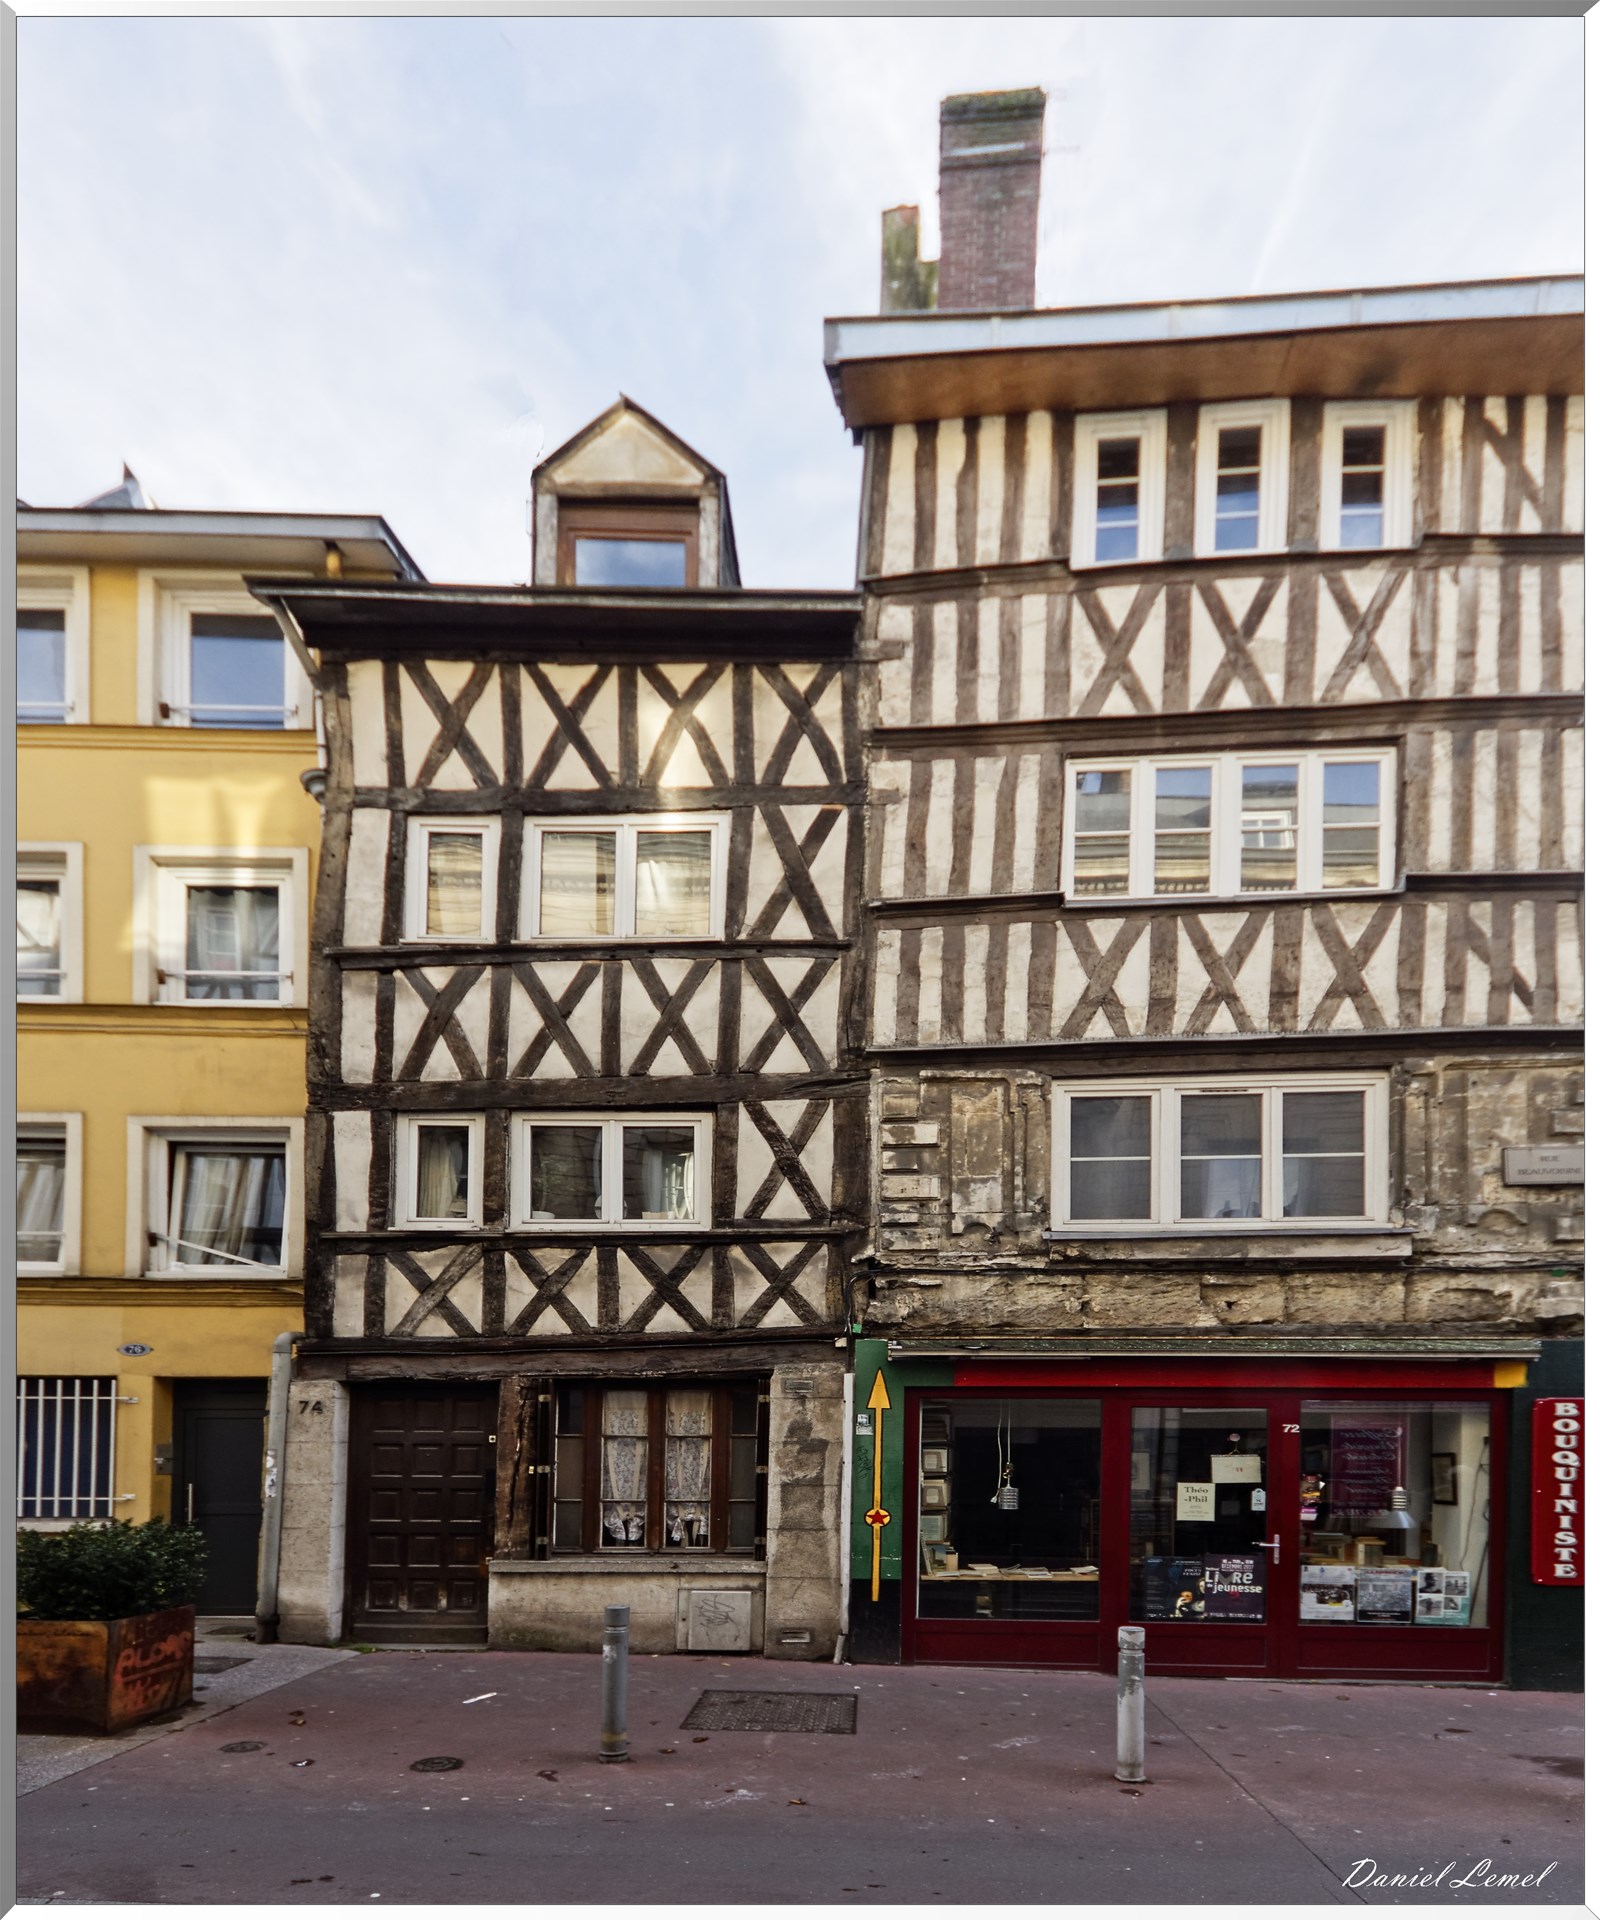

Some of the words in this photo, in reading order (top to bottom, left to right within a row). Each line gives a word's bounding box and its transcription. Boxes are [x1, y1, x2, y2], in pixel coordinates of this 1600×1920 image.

[128, 1345, 142, 1354] 76
[299, 1401, 323, 1415] 74
[1282, 1423, 1300, 1433] 72
[1184, 1486, 1209, 1494] Théo
[1551, 1402, 1581, 1579] BOUQUINISTE
[1212, 1582, 1263, 1594] jeunesse
